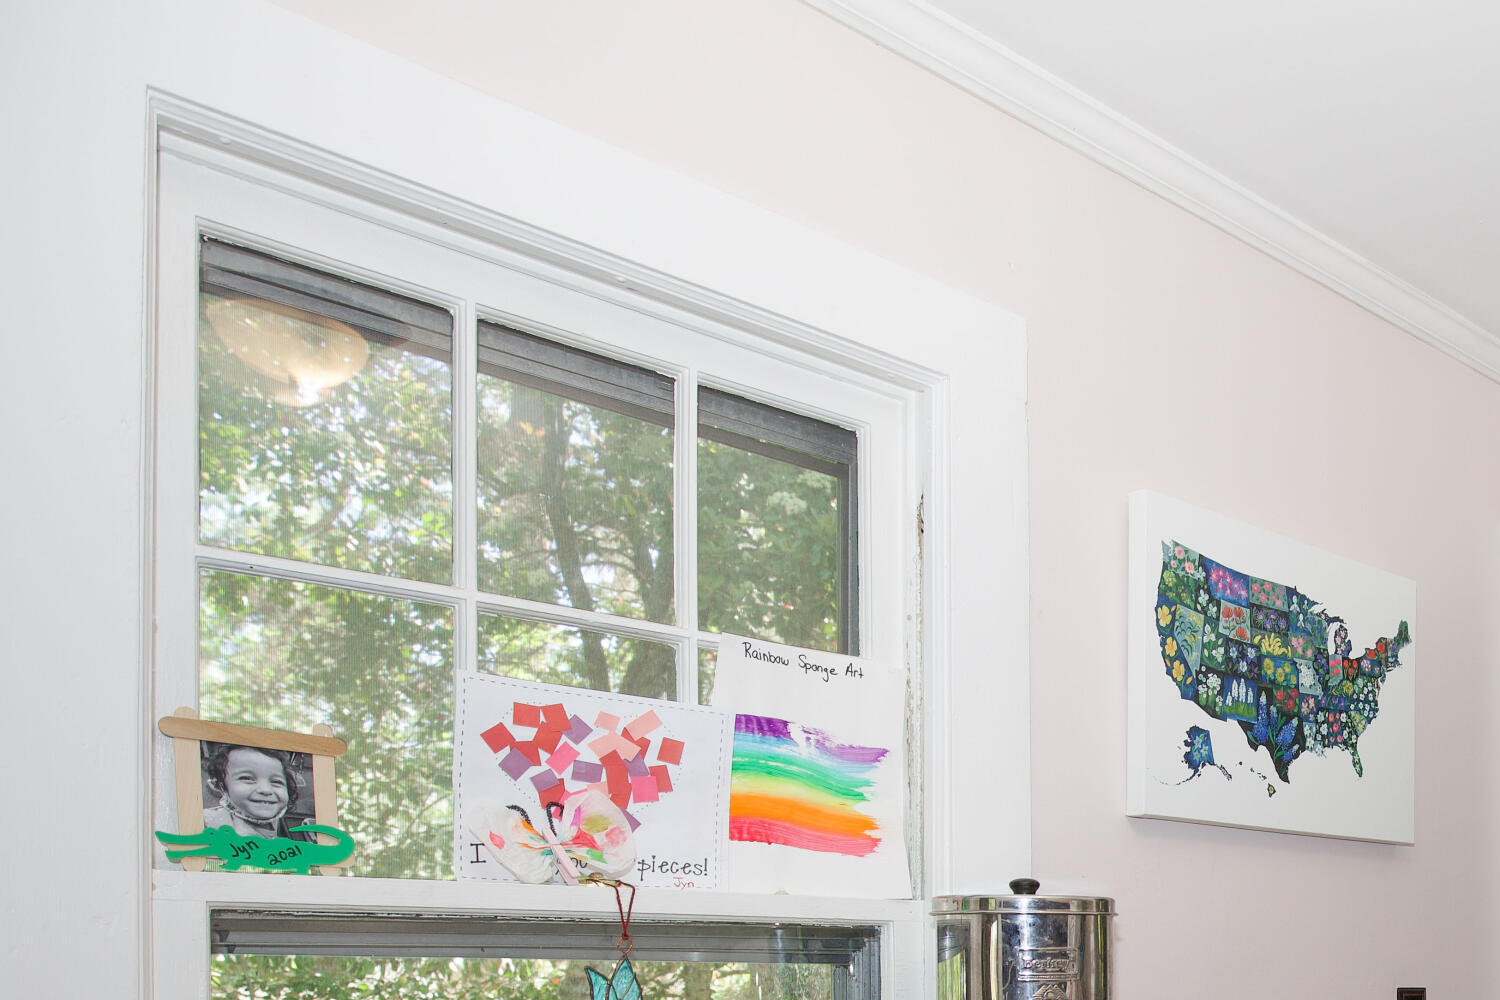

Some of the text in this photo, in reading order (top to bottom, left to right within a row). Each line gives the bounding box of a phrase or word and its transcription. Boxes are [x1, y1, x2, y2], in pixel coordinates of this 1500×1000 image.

[742, 641, 864, 682] Rainbow Sponge Art
[229, 841, 259, 860] Jyn
[470, 843, 486, 864] I
[637, 854, 708, 881] pieces!
[673, 876, 695, 890] Jyn
